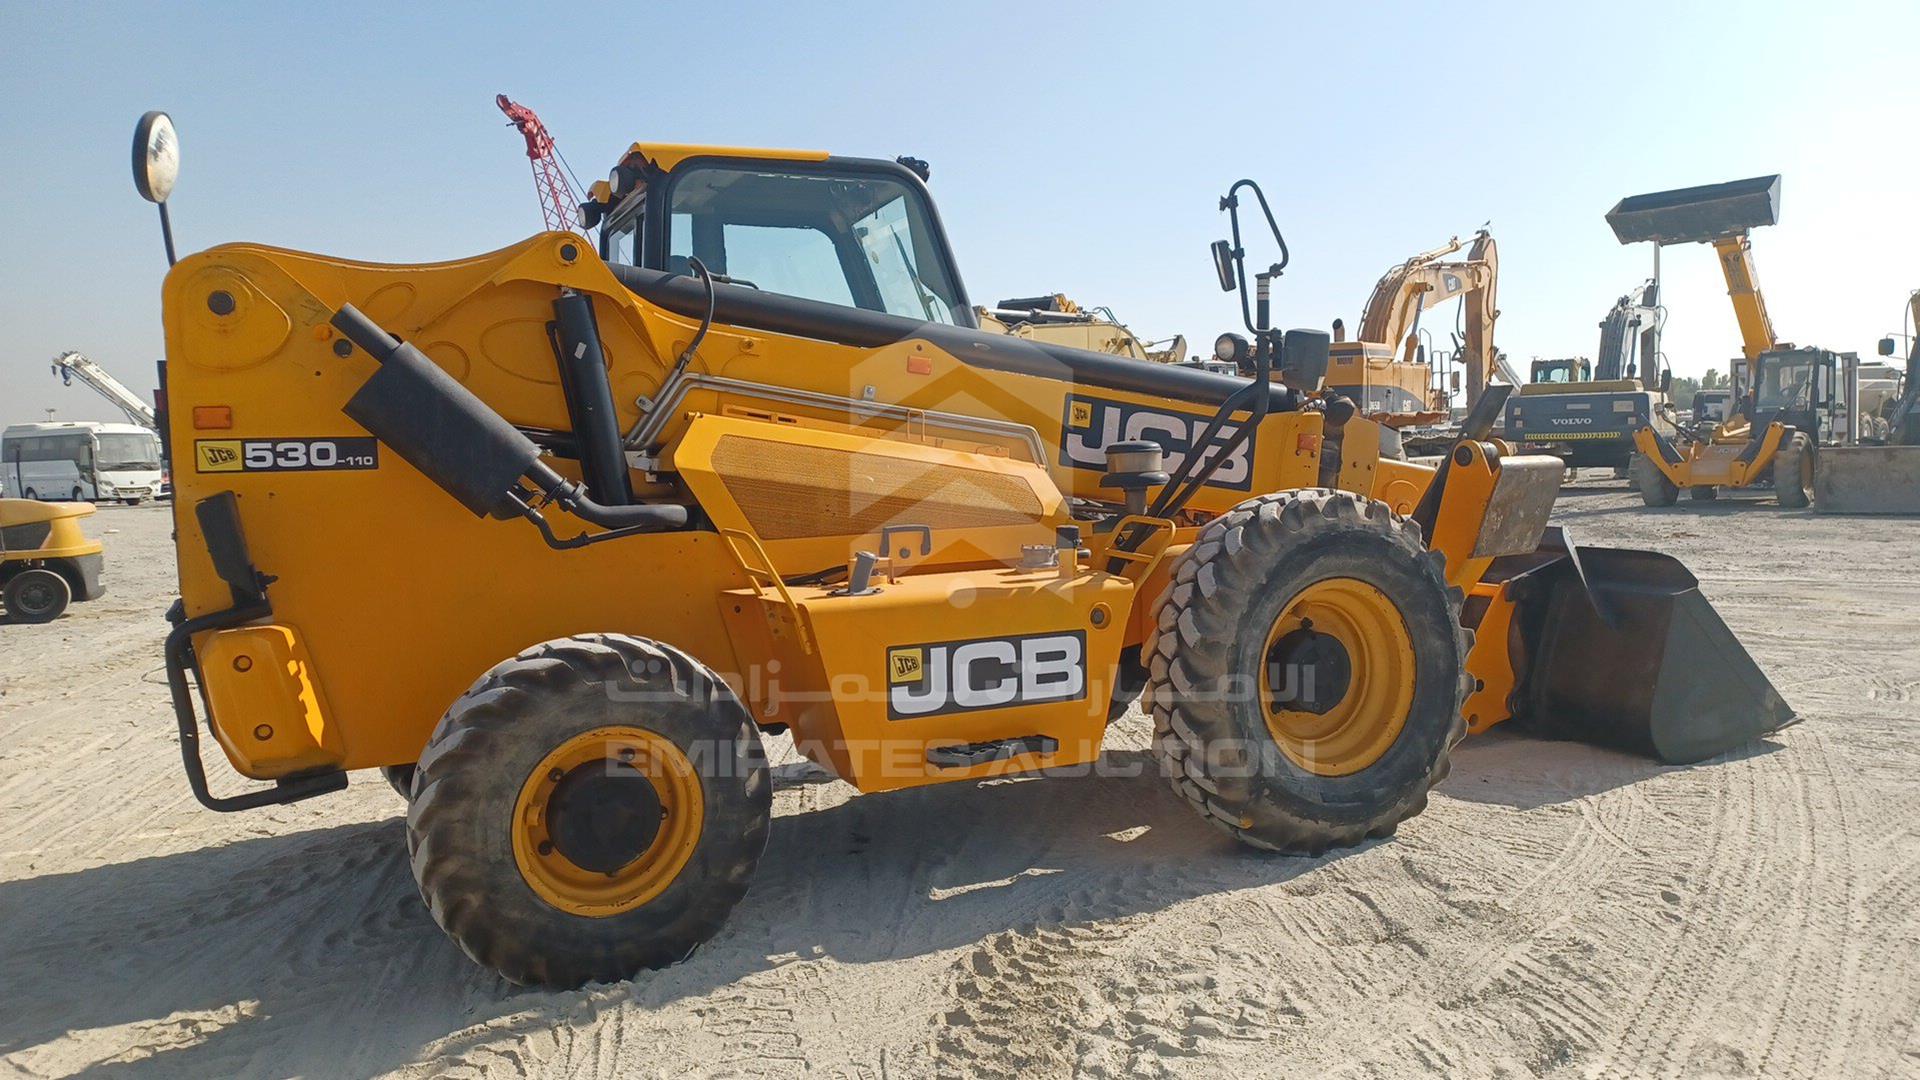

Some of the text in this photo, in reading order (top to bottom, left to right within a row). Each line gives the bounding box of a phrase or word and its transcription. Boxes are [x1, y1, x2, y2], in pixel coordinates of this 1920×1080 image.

[207, 448, 236, 464] JCB
[1066, 406, 1250, 484] JCB
[891, 635, 1083, 714] JCB
[897, 656, 918, 674] JCB
